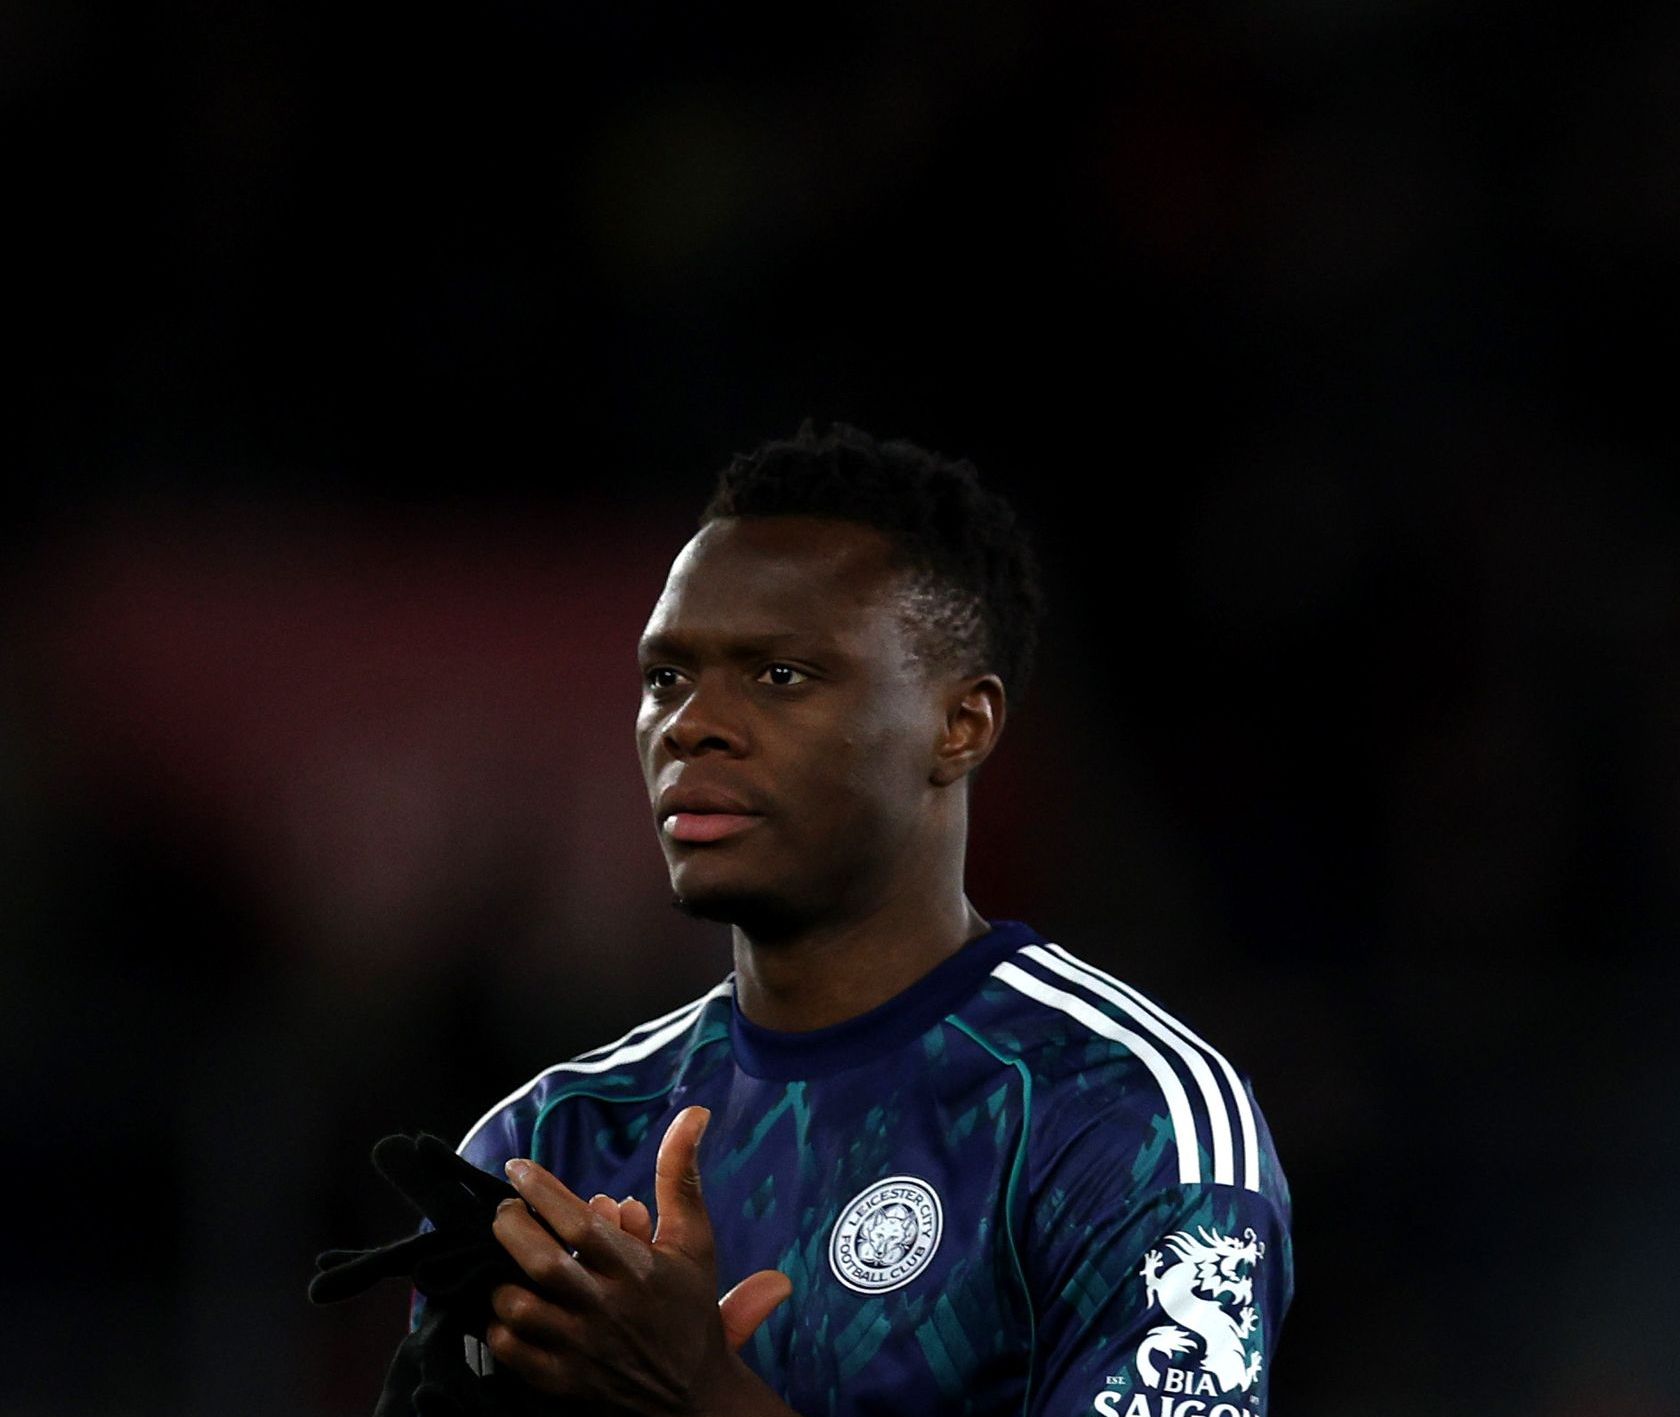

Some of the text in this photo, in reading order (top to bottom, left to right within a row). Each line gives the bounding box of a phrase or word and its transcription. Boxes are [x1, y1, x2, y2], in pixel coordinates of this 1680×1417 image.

[848, 1188, 934, 1238] LEICESTER CITY
[840, 1234, 926, 1282] FOOTBALL CLUB
[1164, 1367, 1218, 1397] BIA
